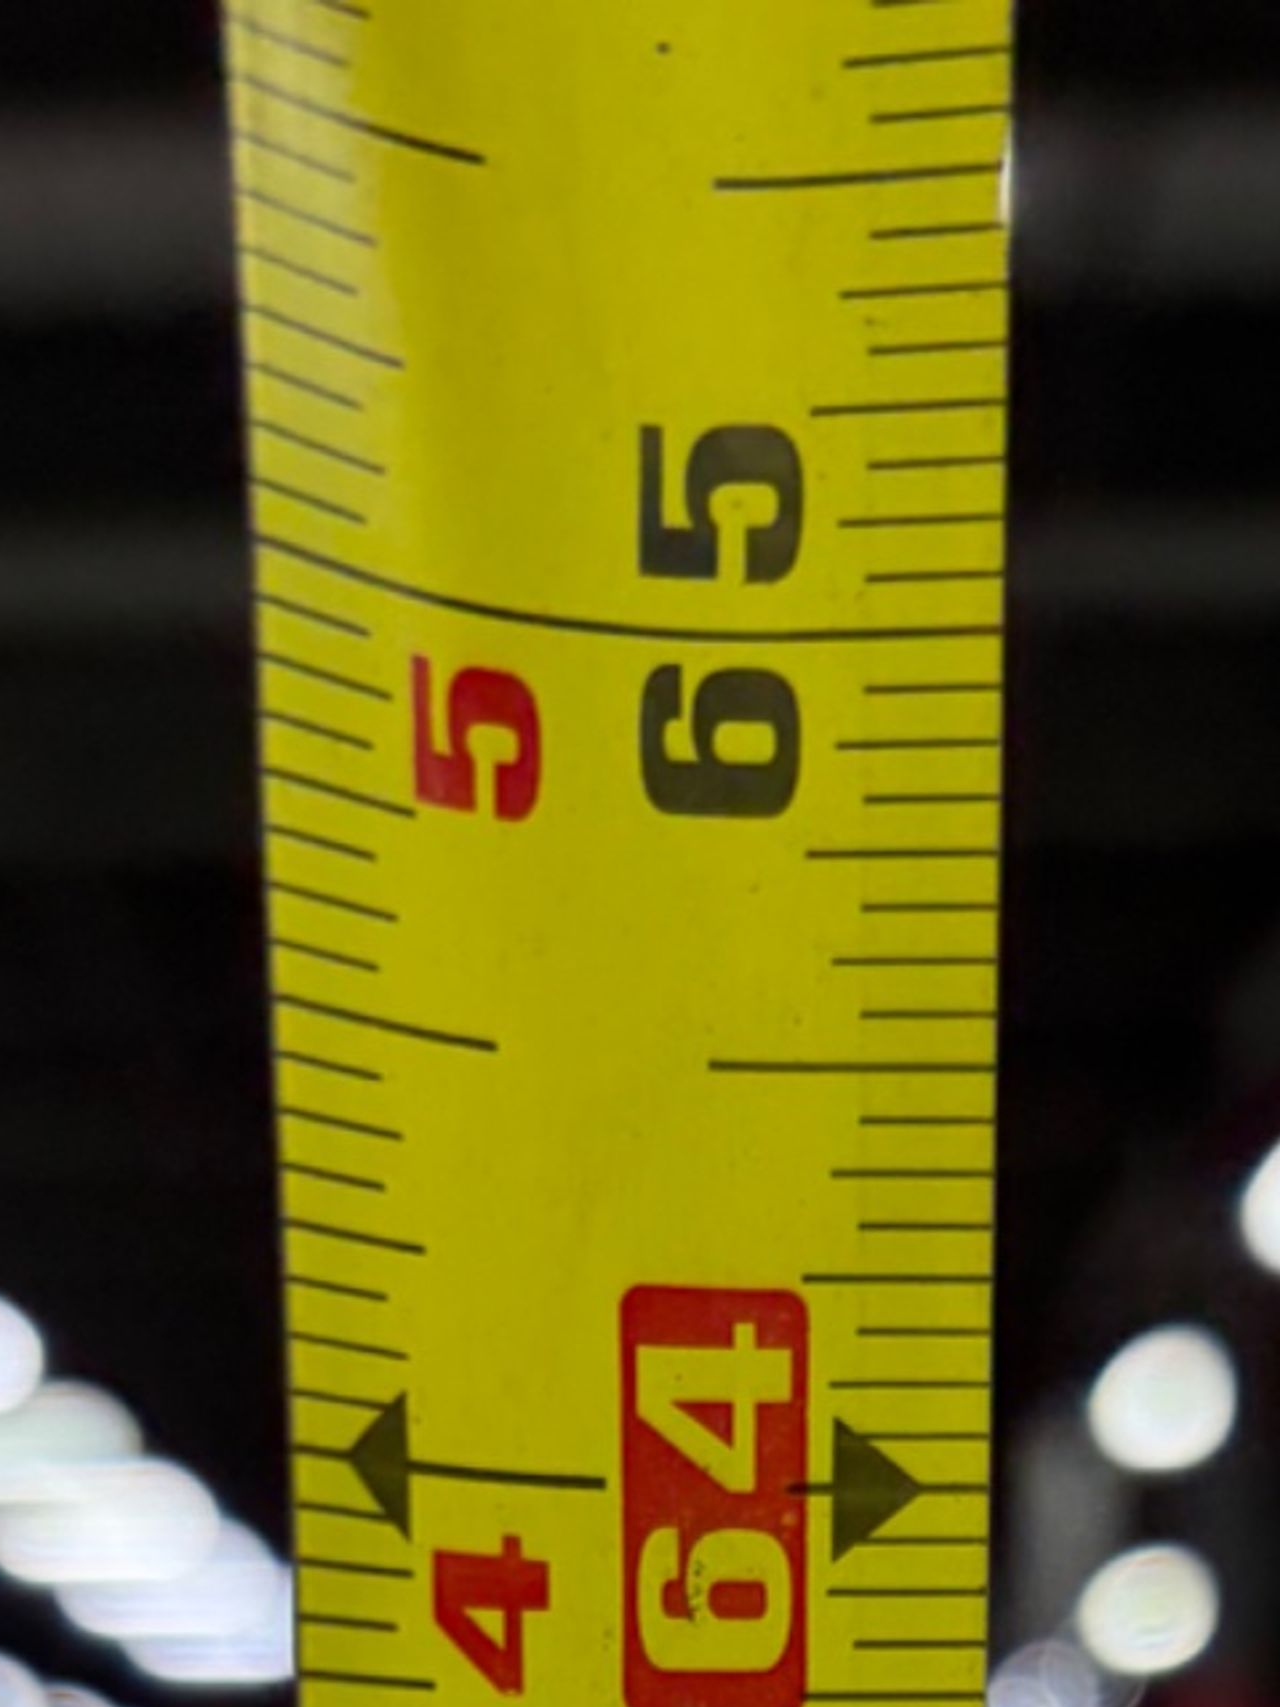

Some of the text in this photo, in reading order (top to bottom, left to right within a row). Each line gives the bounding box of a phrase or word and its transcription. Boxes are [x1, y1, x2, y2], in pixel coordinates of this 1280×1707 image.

[412, 654, 542, 822] 5
[639, 424, 804, 820] 65
[433, 1535, 550, 1695] 4
[636, 1322, 793, 1673] 64
